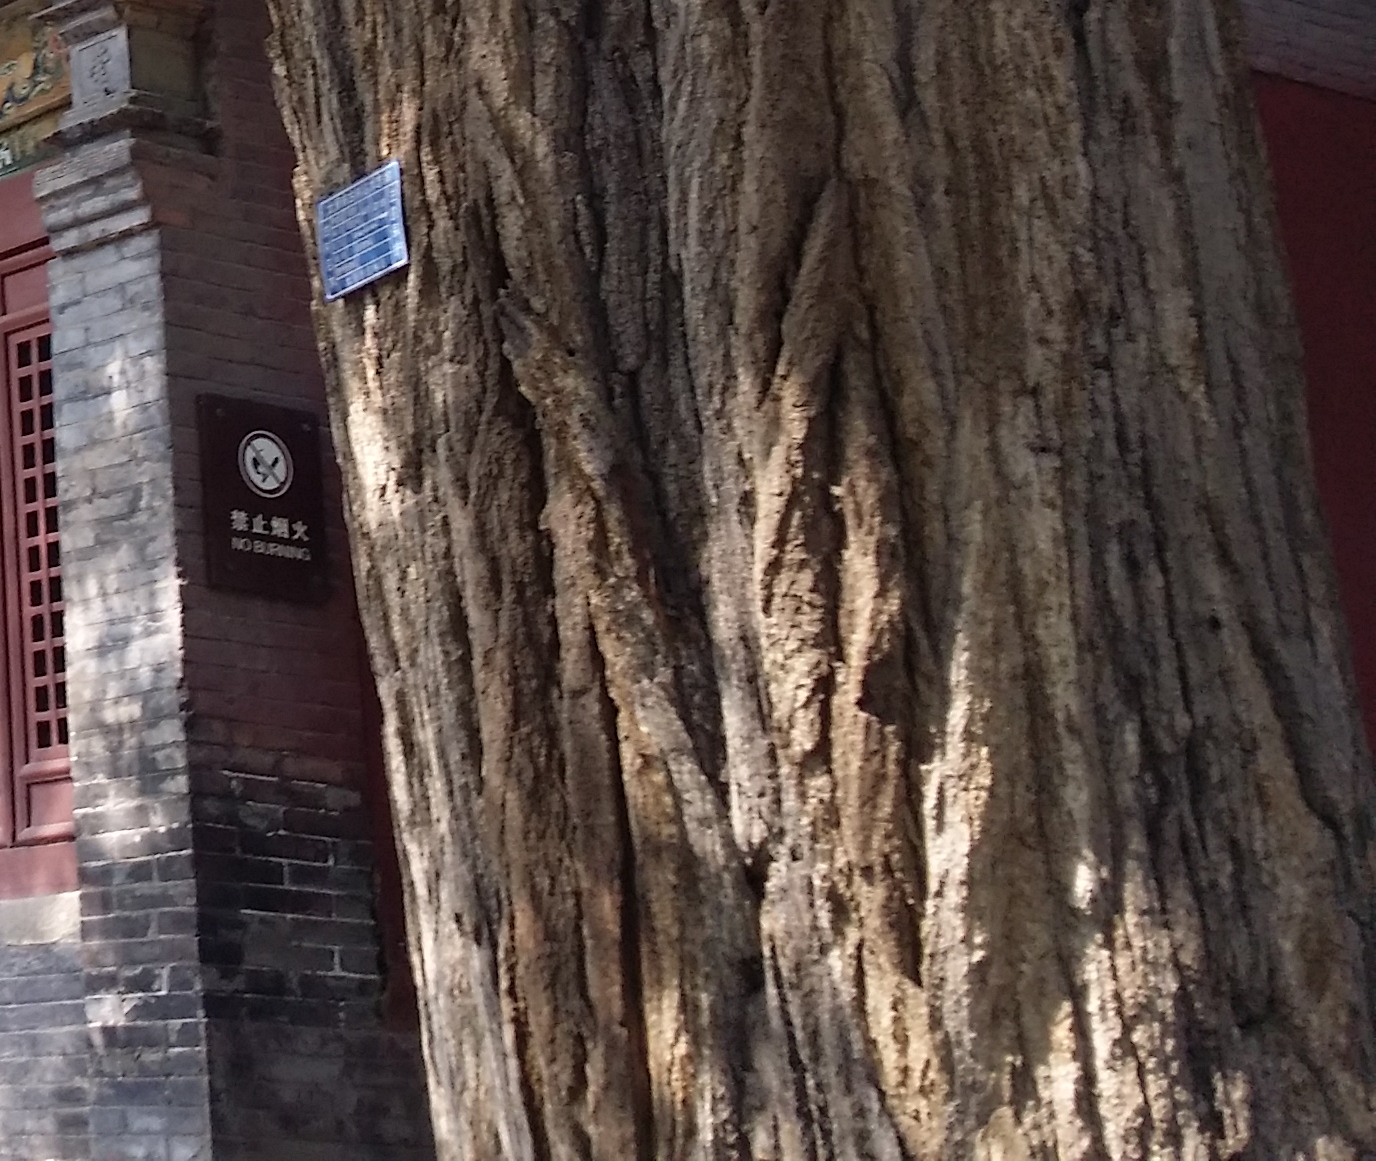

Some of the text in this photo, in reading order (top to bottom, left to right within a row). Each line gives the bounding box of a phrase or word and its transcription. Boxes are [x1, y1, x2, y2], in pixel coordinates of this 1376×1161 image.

[230, 510, 310, 541] 禁止烟火
[232, 537, 311, 560] NO BURNING
